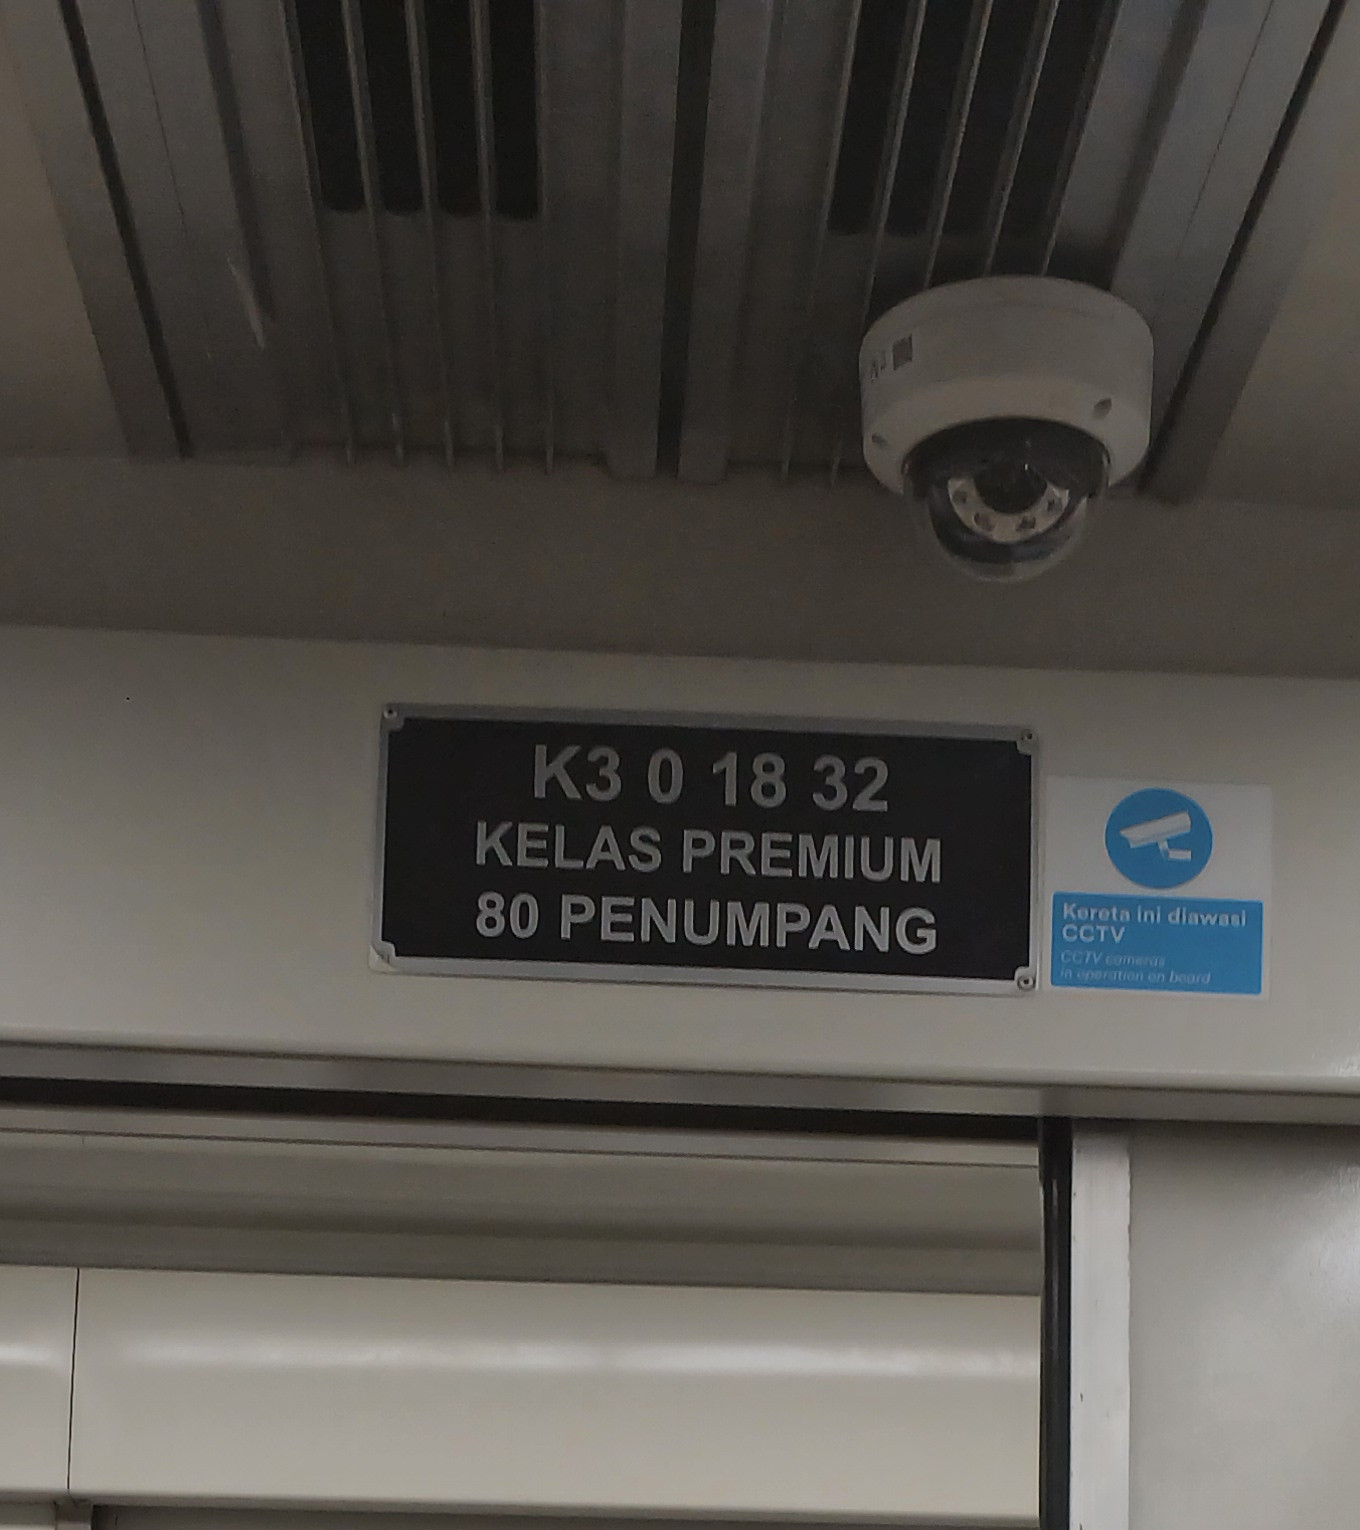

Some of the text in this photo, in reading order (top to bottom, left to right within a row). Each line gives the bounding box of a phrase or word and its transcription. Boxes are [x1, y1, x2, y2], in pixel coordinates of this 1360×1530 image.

[532, 744, 890, 812] K3 0 18 32
[475, 820, 941, 884] KELAS PREMIUM
[475, 891, 938, 954] 80 PENUMPANG
[1062, 925, 1125, 944] CCTV
[1063, 902, 1246, 926] Kereta ini diawasi
